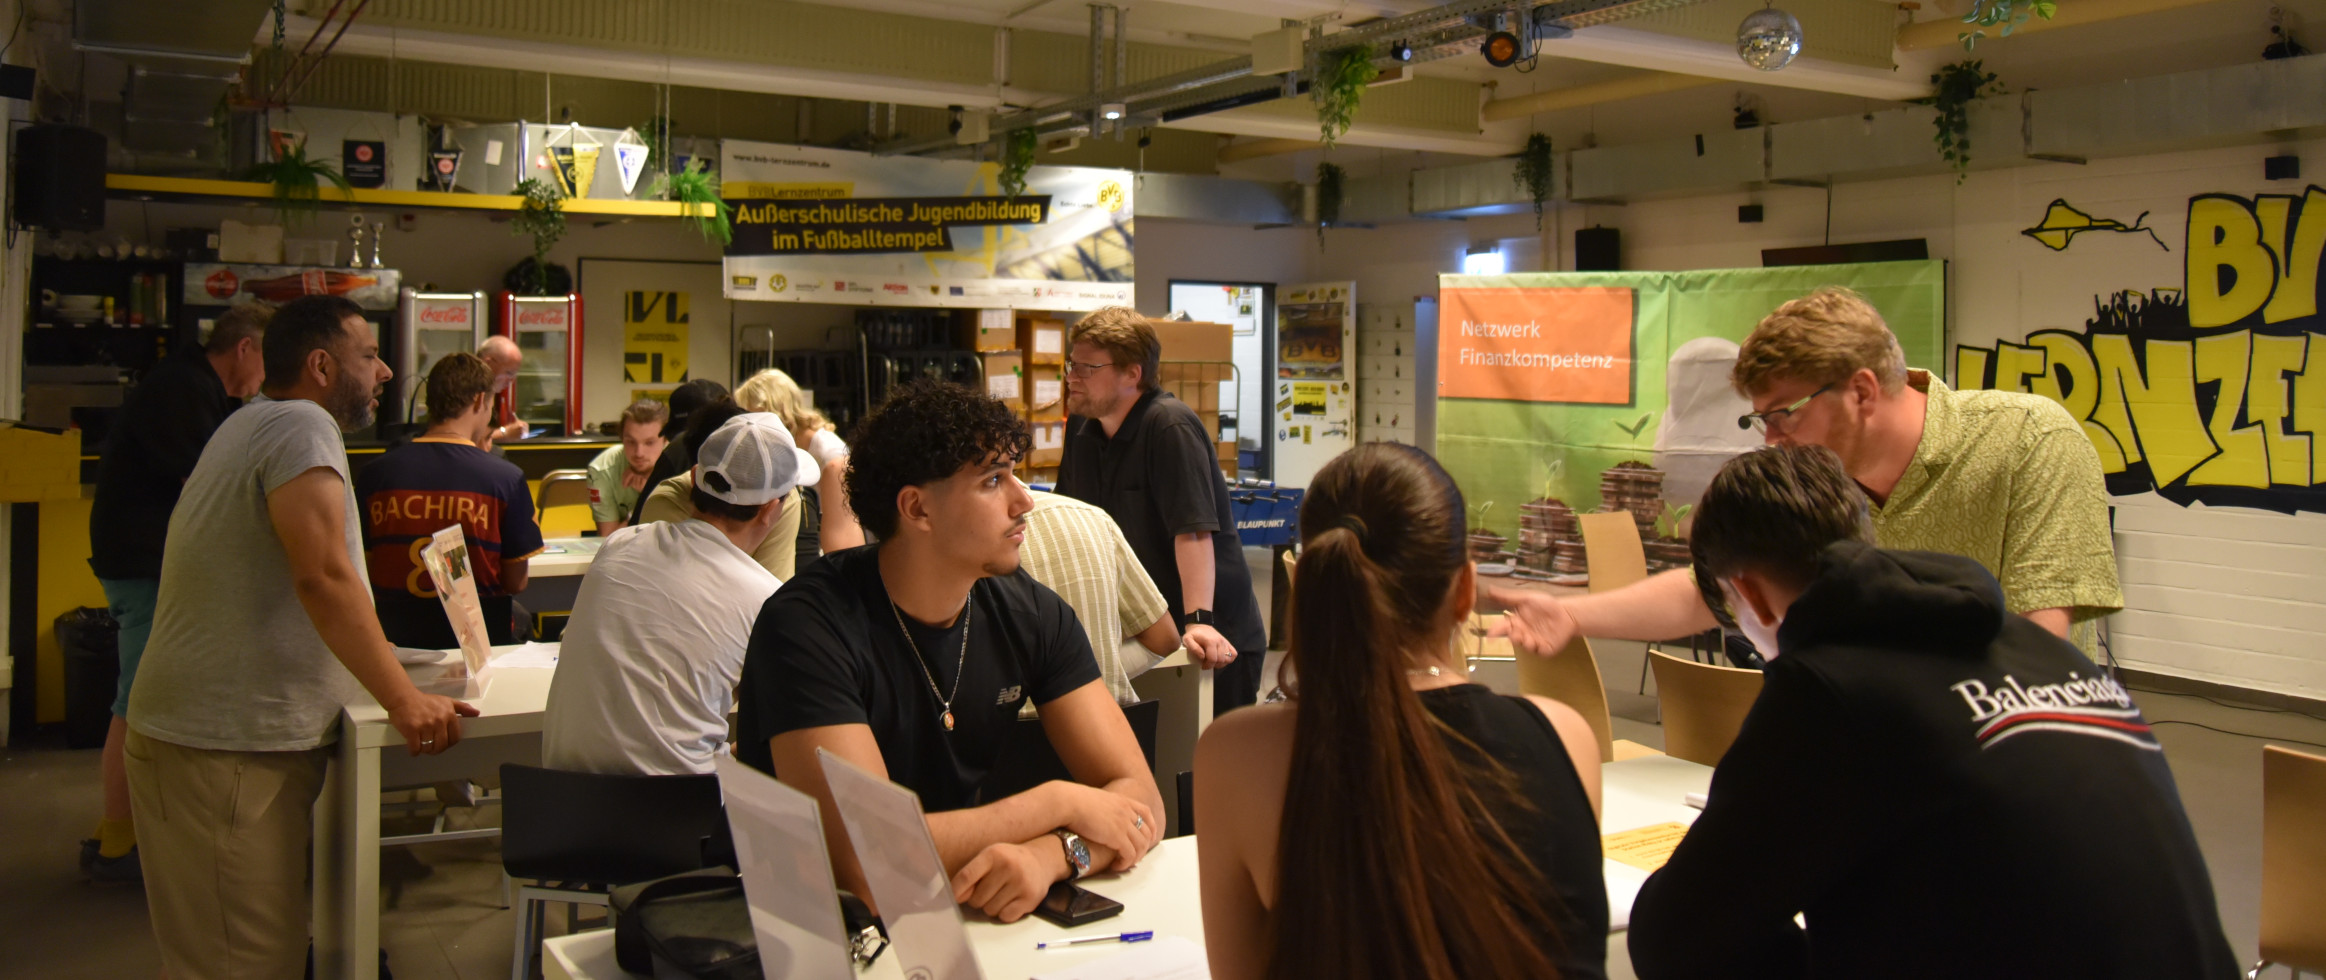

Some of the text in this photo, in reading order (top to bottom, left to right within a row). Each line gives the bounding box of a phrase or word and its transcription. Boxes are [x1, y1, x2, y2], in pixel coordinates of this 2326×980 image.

[733, 154, 830, 168] www.bvb-lernzentrum.de
[1101, 184, 1121, 203] BVB
[736, 201, 1041, 226] Außerschulische Jugendbildung
[772, 227, 944, 251] im Fußballtempel
[420, 306, 467, 323] Coca-Cola
[519, 309, 564, 325] Coca-Cola
[1461, 320, 1541, 338] Netzwerk
[1460, 348, 1613, 371] Finanzkompetenz
[370, 495, 489, 530] BACHIRA
[1237, 519, 1285, 529] BLAUPUNKT
